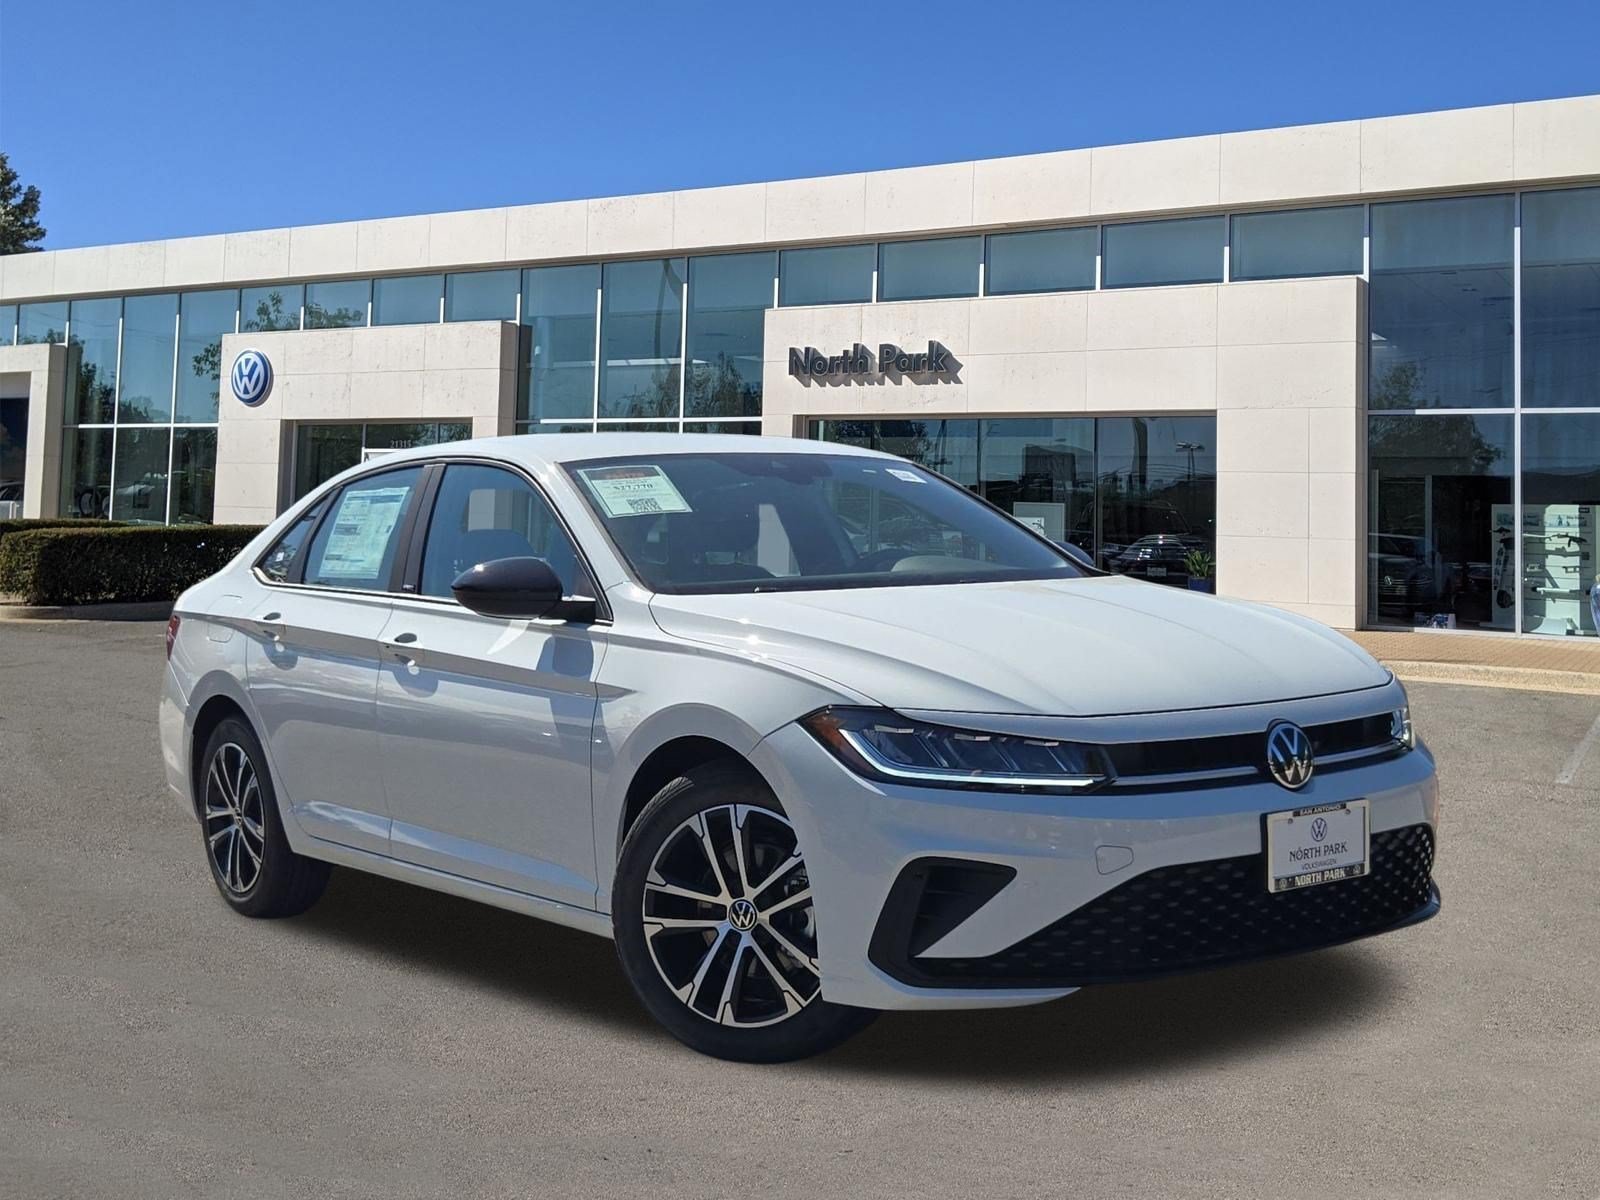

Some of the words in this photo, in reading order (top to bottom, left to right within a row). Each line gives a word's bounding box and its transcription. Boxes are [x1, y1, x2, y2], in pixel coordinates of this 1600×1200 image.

[788, 342, 874, 377] North
[878, 340, 948, 373] Park
[1289, 846, 1321, 862] NORTH
[1323, 842, 1348, 857] PARK
[1294, 873, 1322, 886] NORTH
[1324, 868, 1346, 881] PARK
